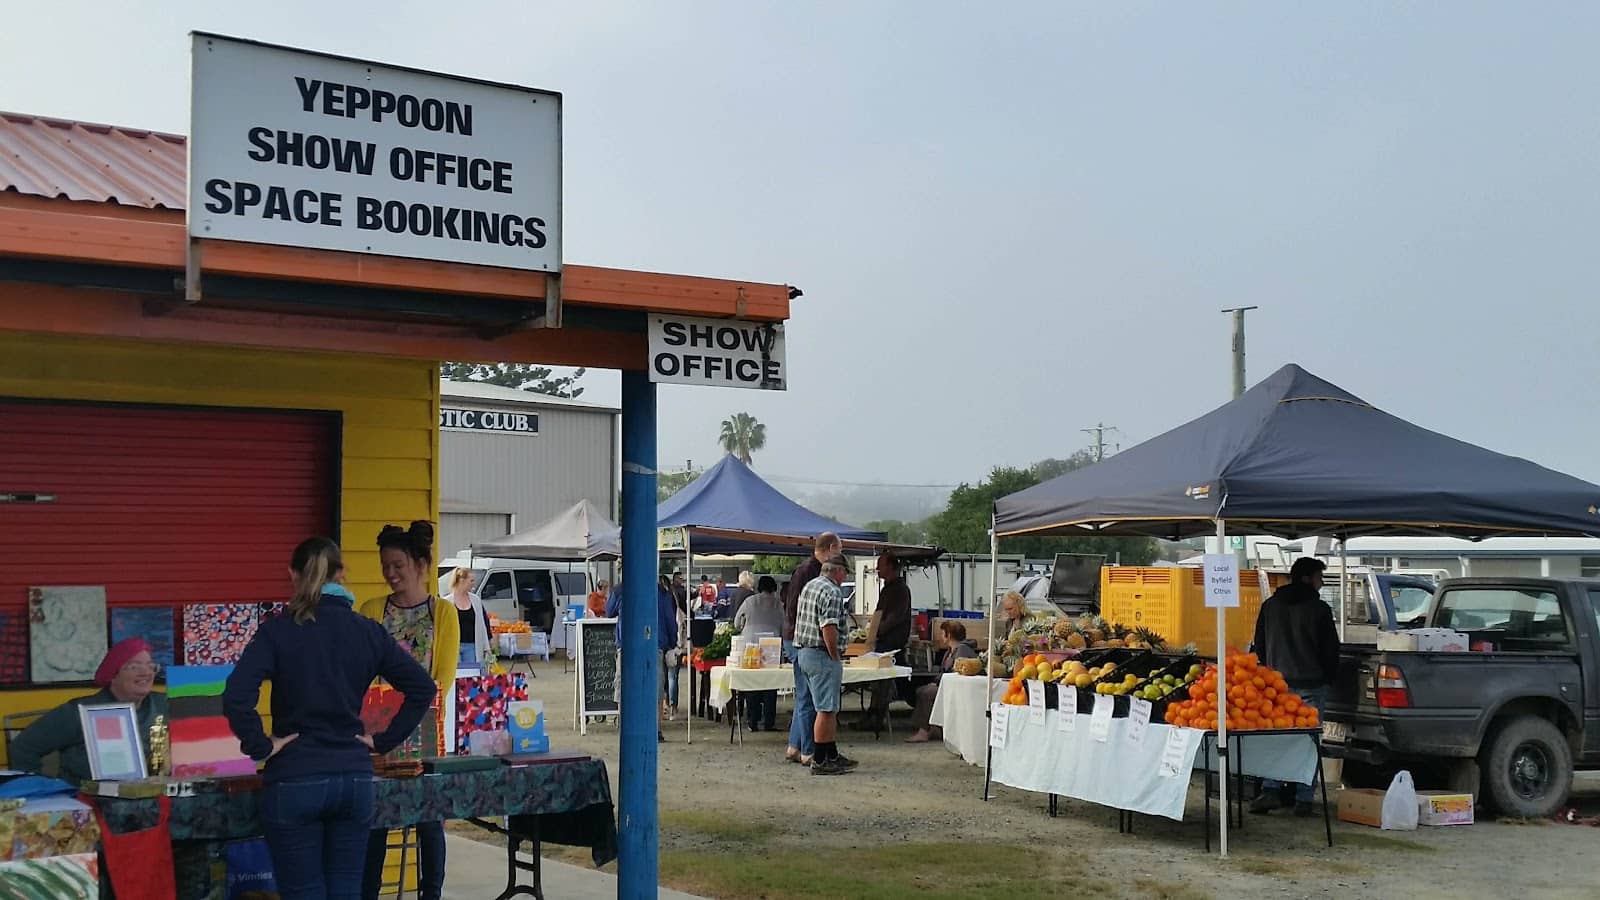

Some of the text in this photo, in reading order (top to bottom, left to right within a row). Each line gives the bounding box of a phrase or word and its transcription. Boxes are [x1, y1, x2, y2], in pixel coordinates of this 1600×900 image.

[294, 77, 472, 136] YEPPOON
[248, 127, 513, 194] SHOW OFFICE
[204, 179, 547, 249] SPACE BOOKINGS
[663, 322, 771, 353] SHOW
[654, 352, 782, 384] OFFICE
[1211, 576, 1232, 585] Byfield
[1213, 587, 1232, 595] Citrus
